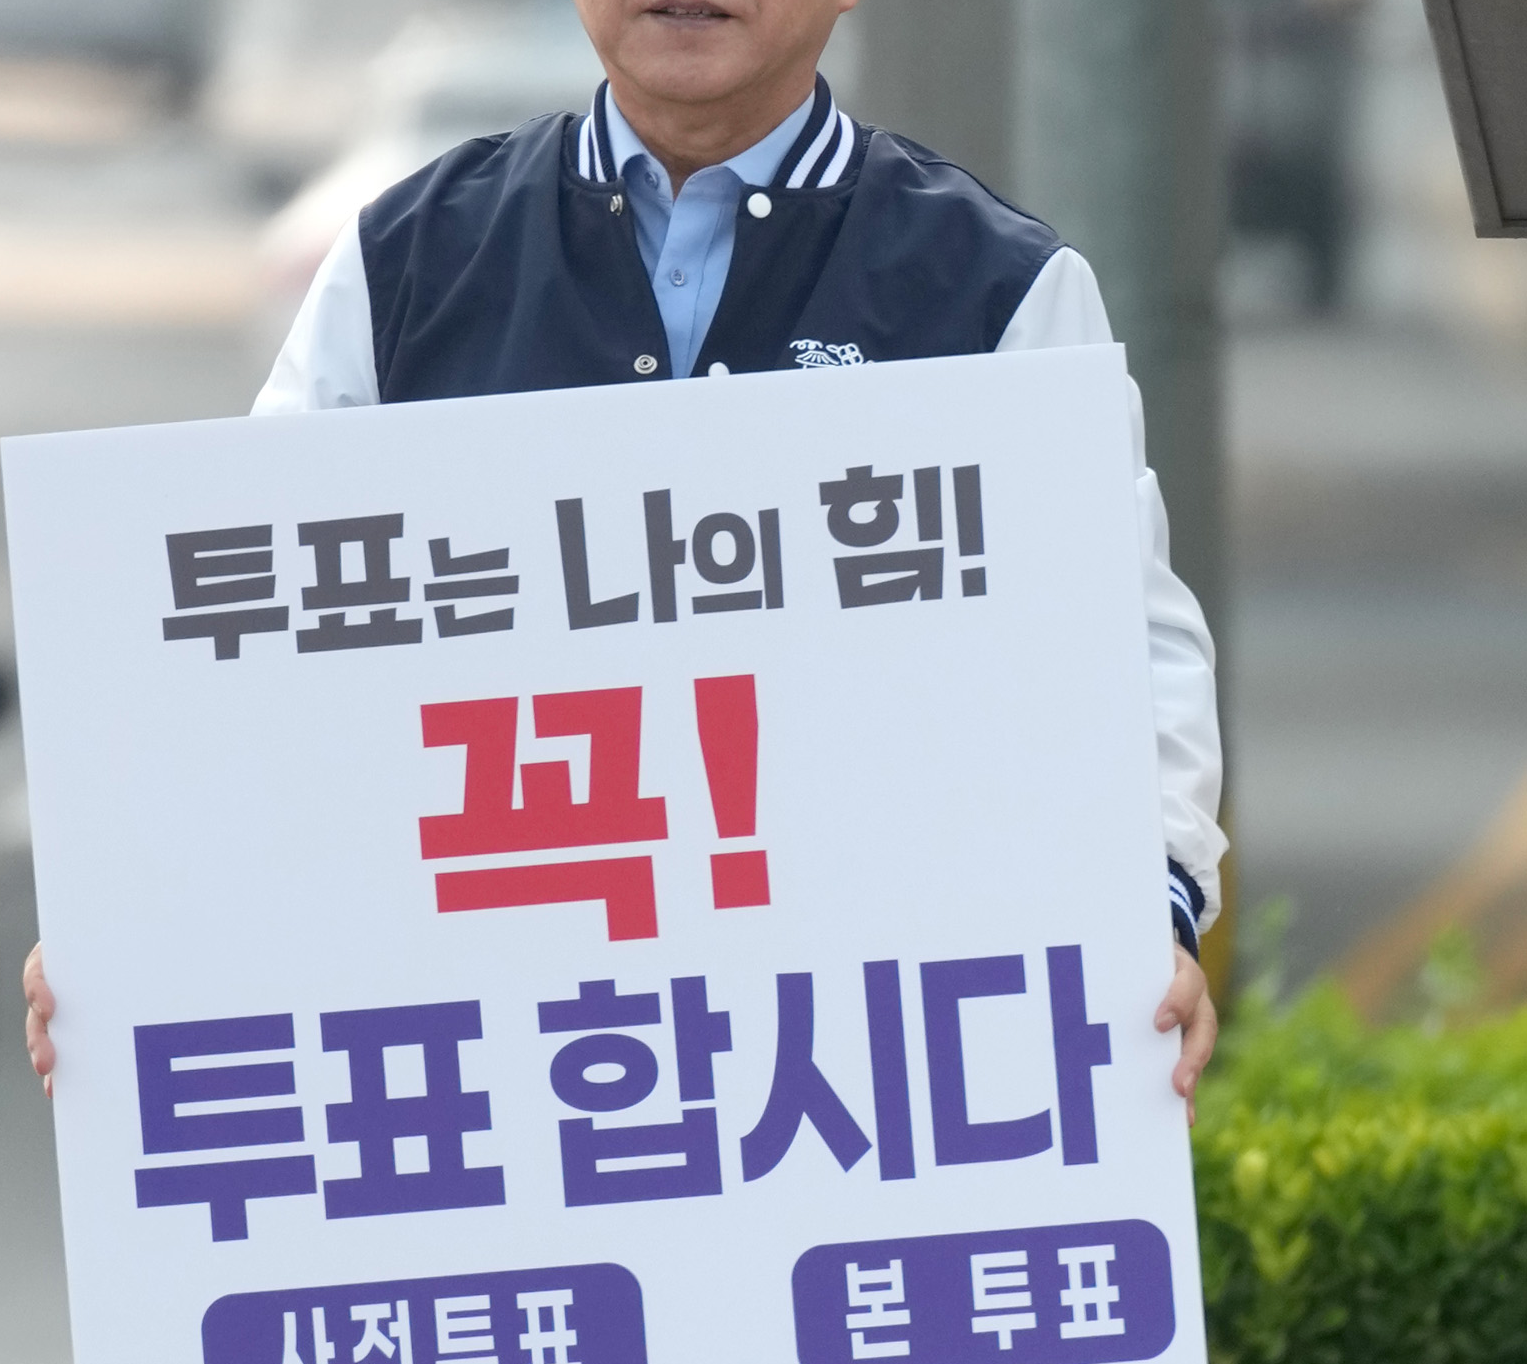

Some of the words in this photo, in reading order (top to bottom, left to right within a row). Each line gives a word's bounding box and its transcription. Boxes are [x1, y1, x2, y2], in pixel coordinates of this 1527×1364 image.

[162, 511, 520, 661] 투표는
[554, 488, 785, 631] 나의
[818, 463, 988, 610] 힘!
[418, 673, 771, 942] 꼭!
